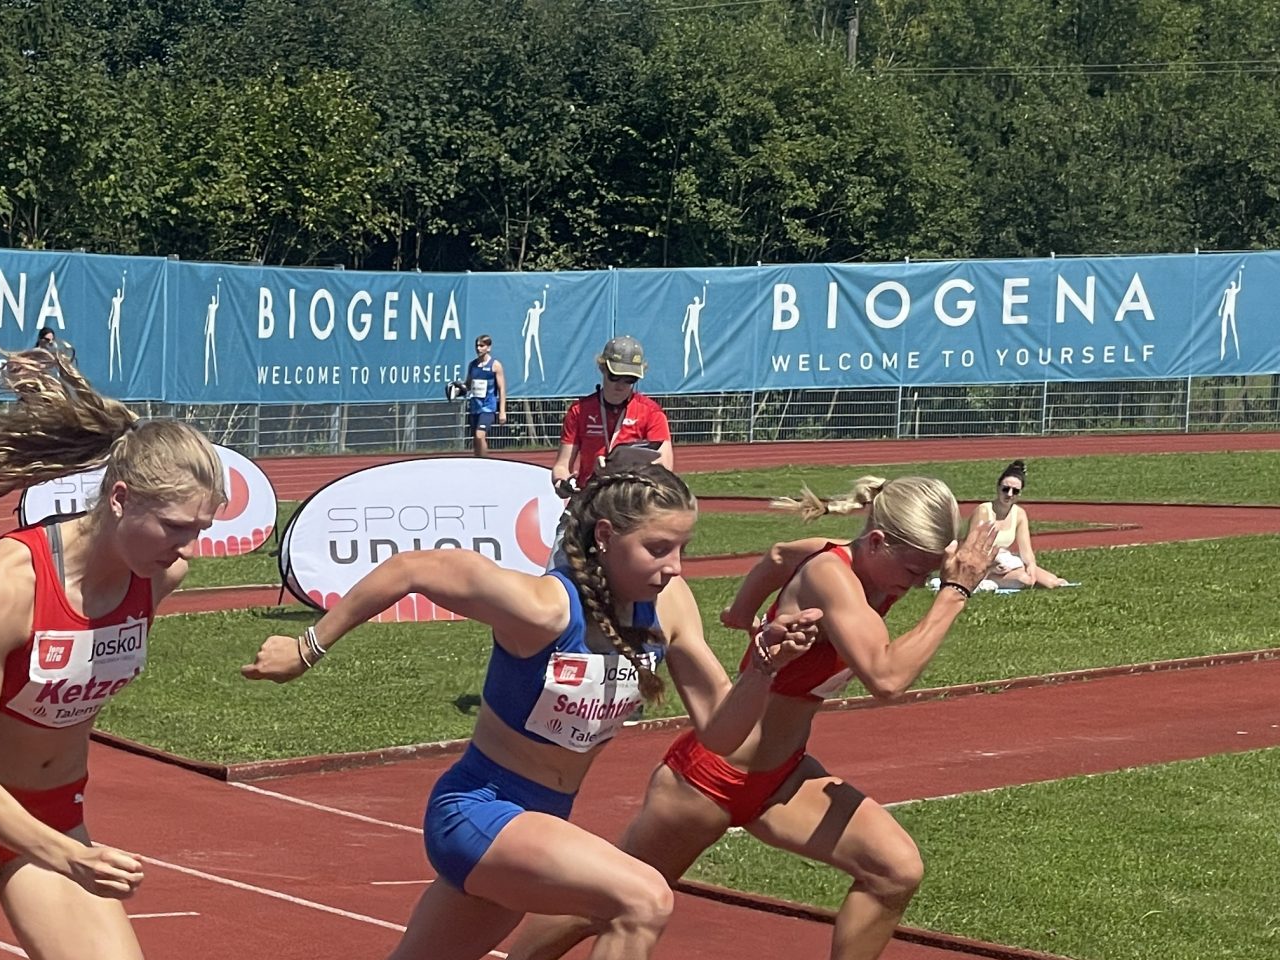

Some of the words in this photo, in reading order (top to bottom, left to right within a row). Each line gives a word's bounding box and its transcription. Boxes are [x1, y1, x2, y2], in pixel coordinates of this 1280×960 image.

[257, 286, 462, 342] BIOGENA
[771, 271, 1156, 332] BIOGENA
[771, 351, 920, 374] WELCOME
[942, 349, 975, 368] TO
[996, 344, 1156, 367] YOURSELF
[257, 365, 340, 385] WELCOME
[351, 366, 370, 384] TO
[380, 364, 462, 385] YOURSELF
[327, 504, 499, 534] SPORT
[88, 628, 138, 662] josko
[600, 666, 638, 685] josk
